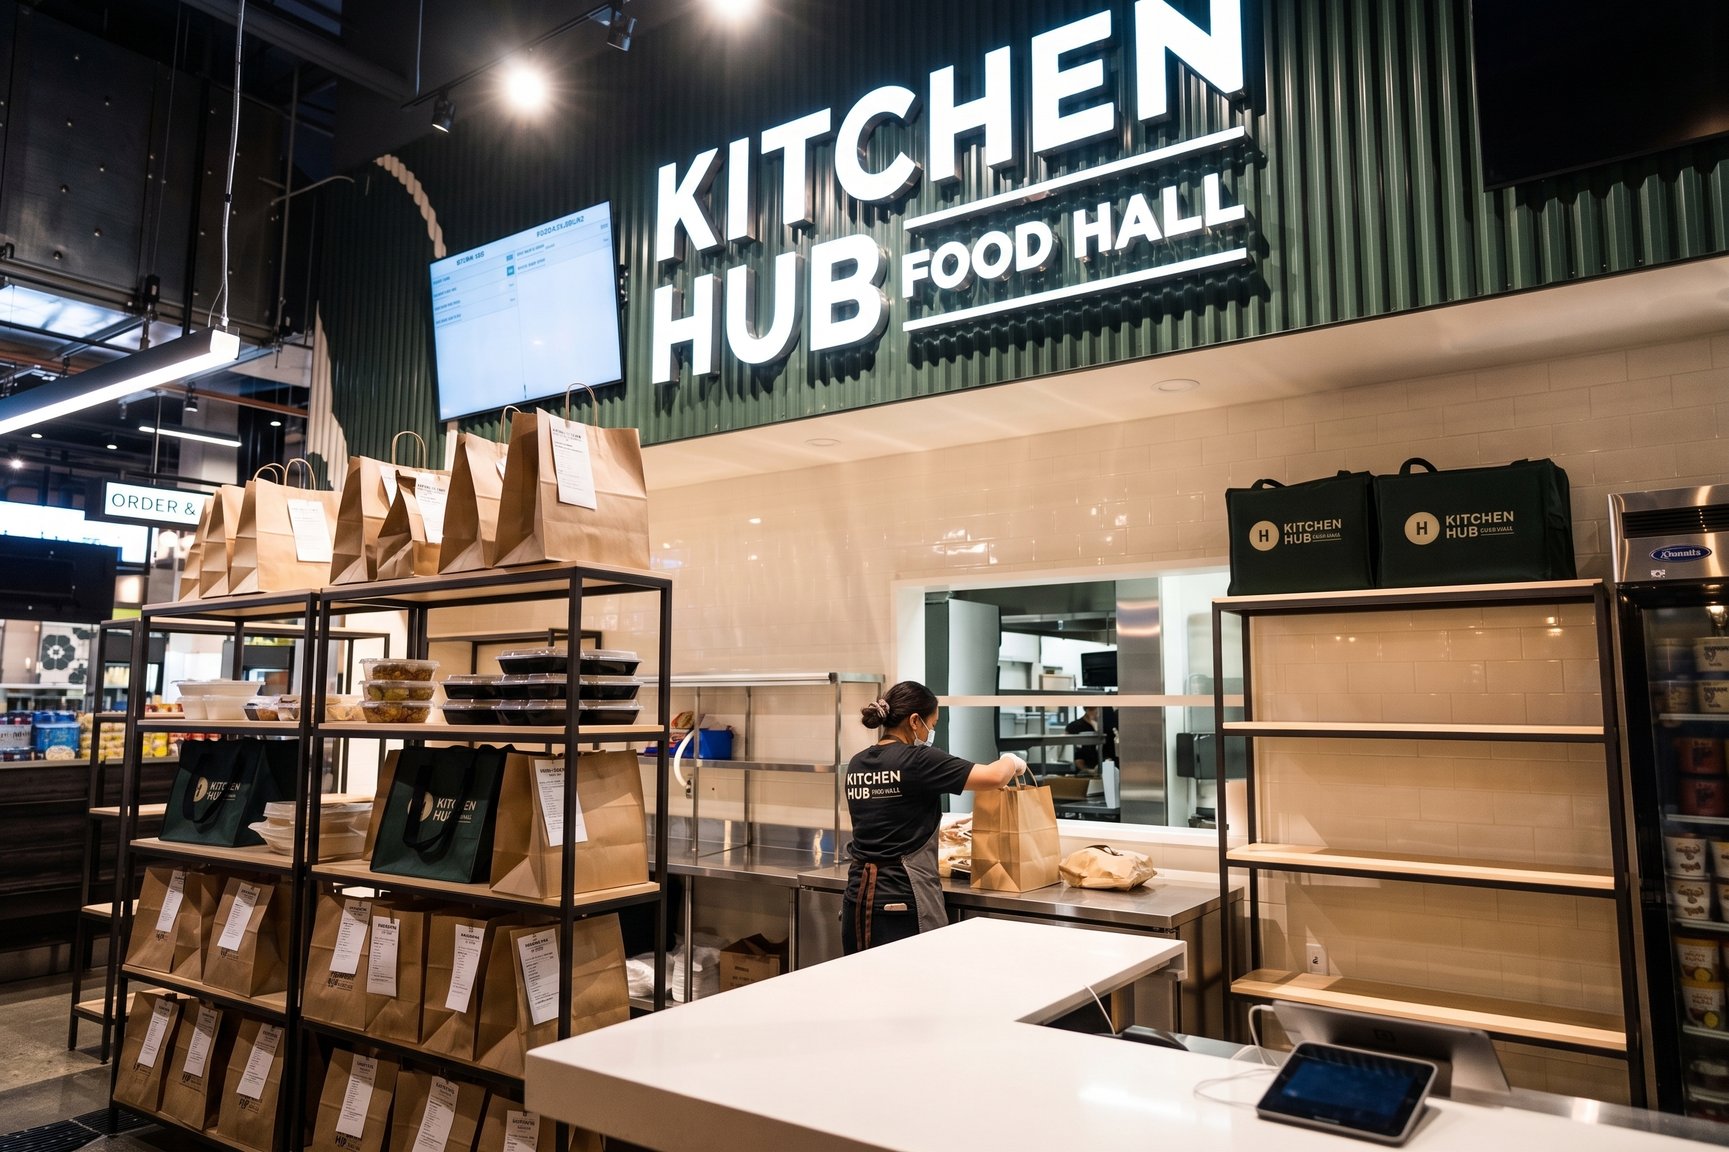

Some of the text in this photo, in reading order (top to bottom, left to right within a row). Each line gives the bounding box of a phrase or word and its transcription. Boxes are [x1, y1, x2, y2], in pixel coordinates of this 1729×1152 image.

[657, 0, 1244, 262] KITCHEN
[902, 172, 1246, 298] FOOD HALL
[652, 234, 882, 384] HUB
[112, 493, 196, 515] ORDER &
[1445, 511, 1514, 526] KITCHEN
[1284, 519, 1342, 533] KITCHEN
[1446, 526, 1478, 538] HUB
[1284, 533, 1312, 544] HUB
[847, 770, 901, 785] KITCHEN
[210, 781, 240, 791] KITCEN
[847, 787, 870, 799] HUB
[437, 798, 477, 811] KITCEN
